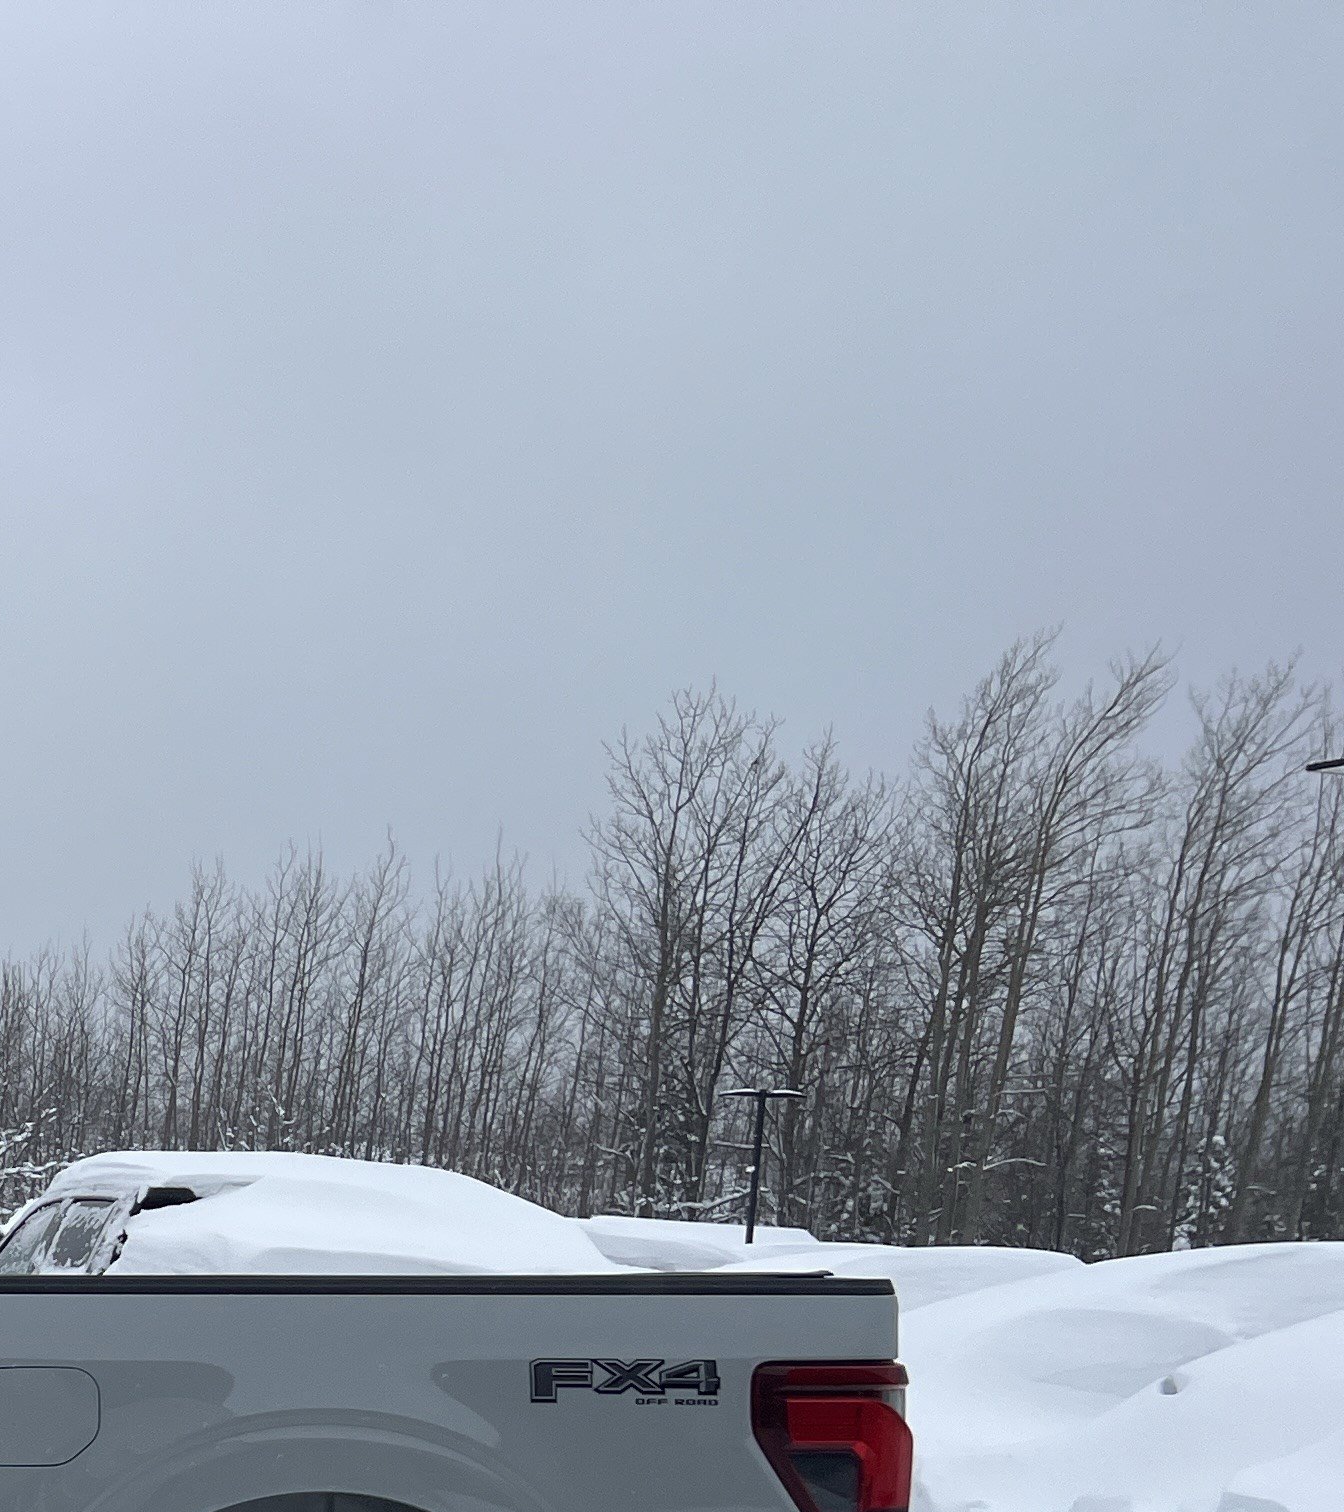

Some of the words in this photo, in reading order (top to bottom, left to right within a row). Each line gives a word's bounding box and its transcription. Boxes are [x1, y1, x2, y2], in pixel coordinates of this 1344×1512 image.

[529, 1358, 720, 1403] FX4
[635, 1398, 668, 1406] OFF
[674, 1398, 719, 1406] ROAD
